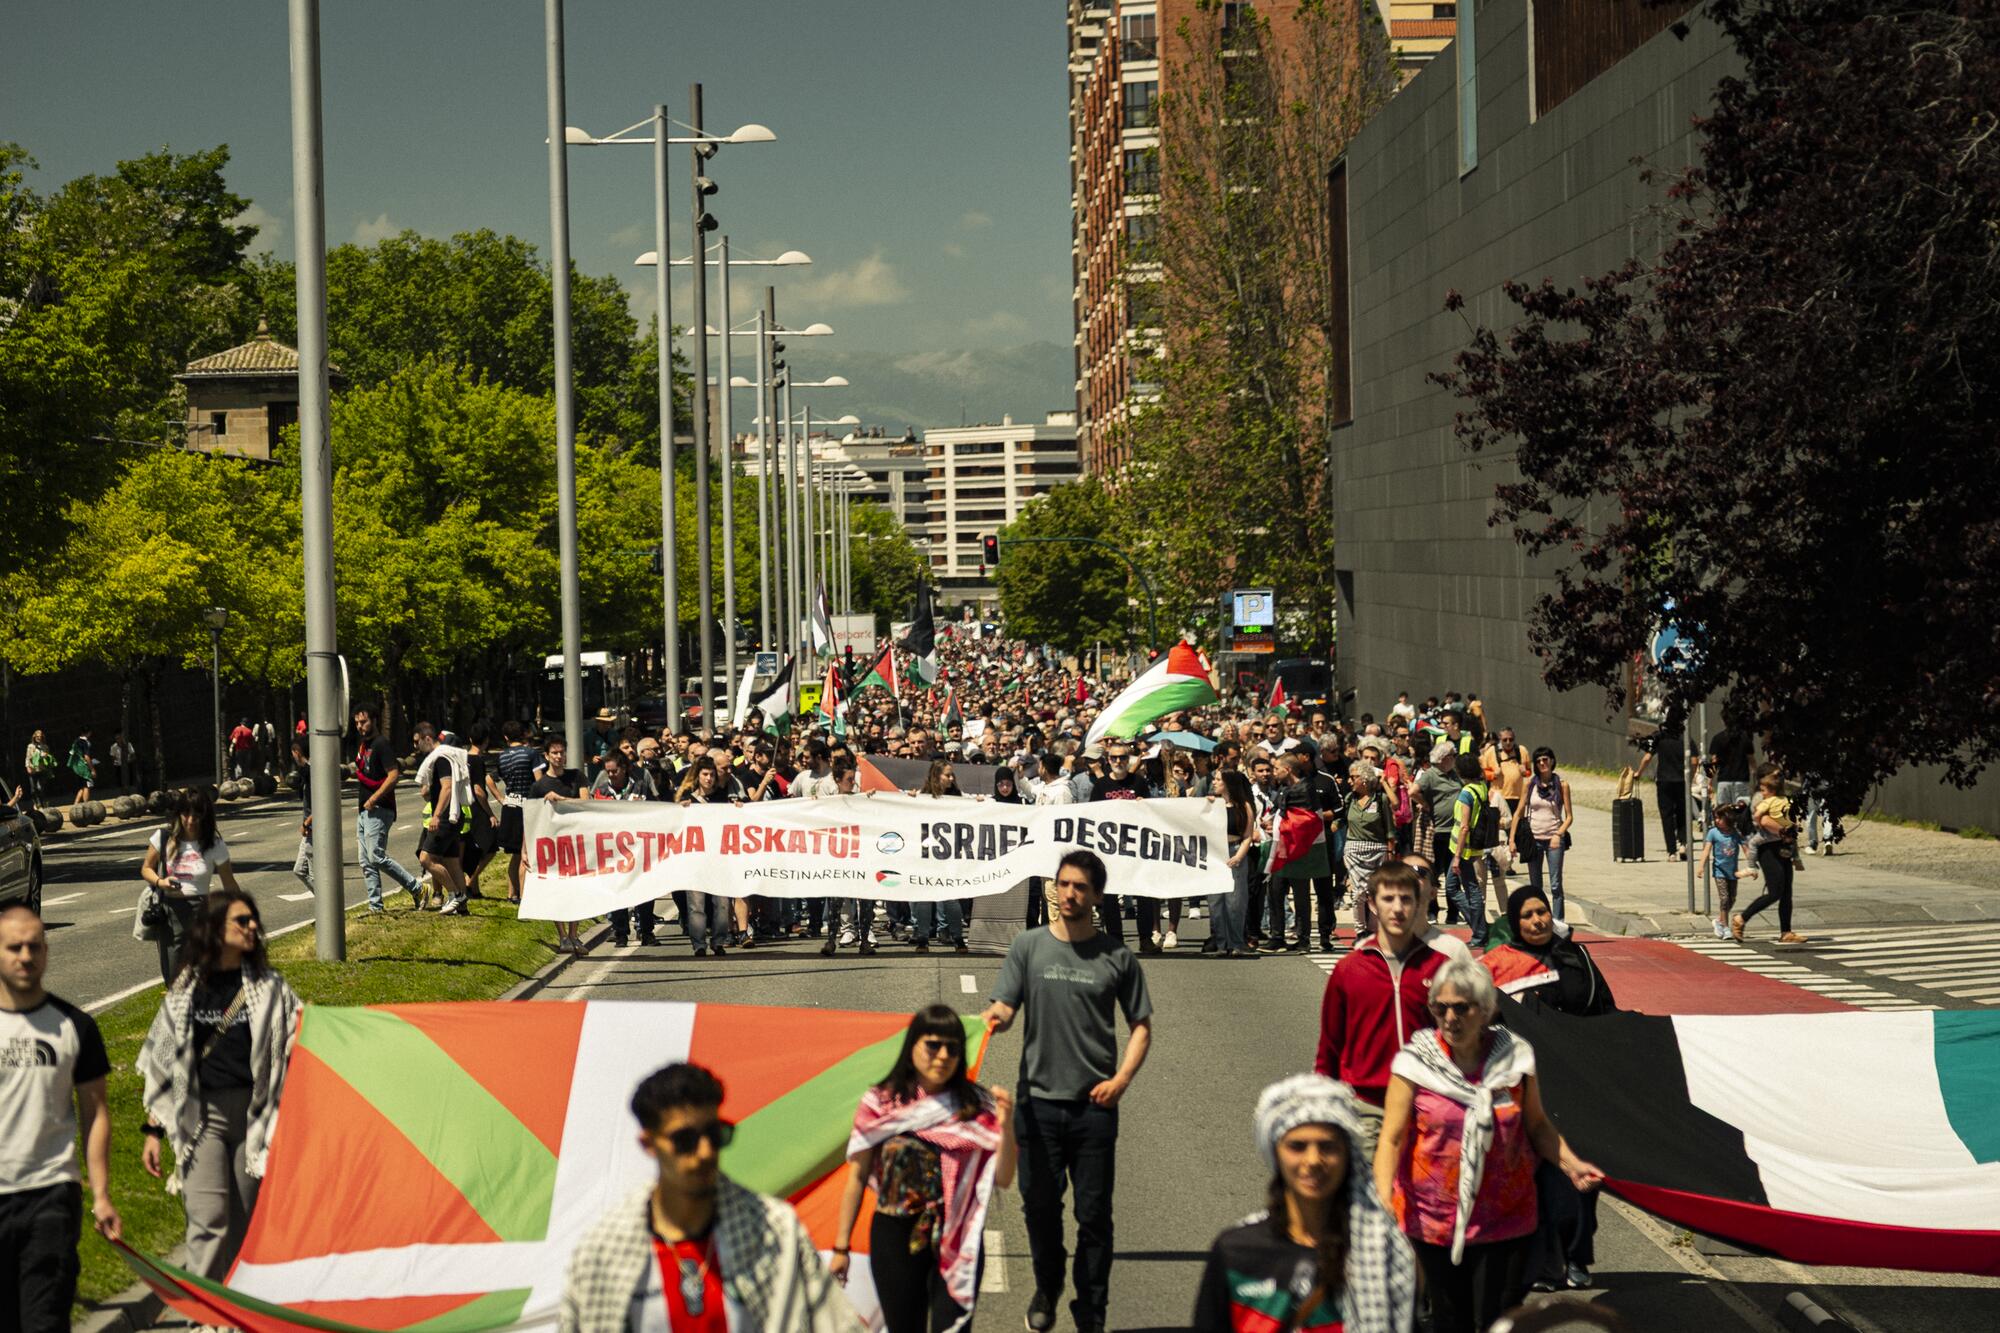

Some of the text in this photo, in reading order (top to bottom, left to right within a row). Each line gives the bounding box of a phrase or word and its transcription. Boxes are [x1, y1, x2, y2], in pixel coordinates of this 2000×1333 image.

[1243, 595, 1264, 622] P
[536, 817, 1208, 879] PALESTINA ASKATU! ISRAEL DESEGIN!
[744, 867, 1011, 887] PALESTINAREKIN ELKARTASUNA
